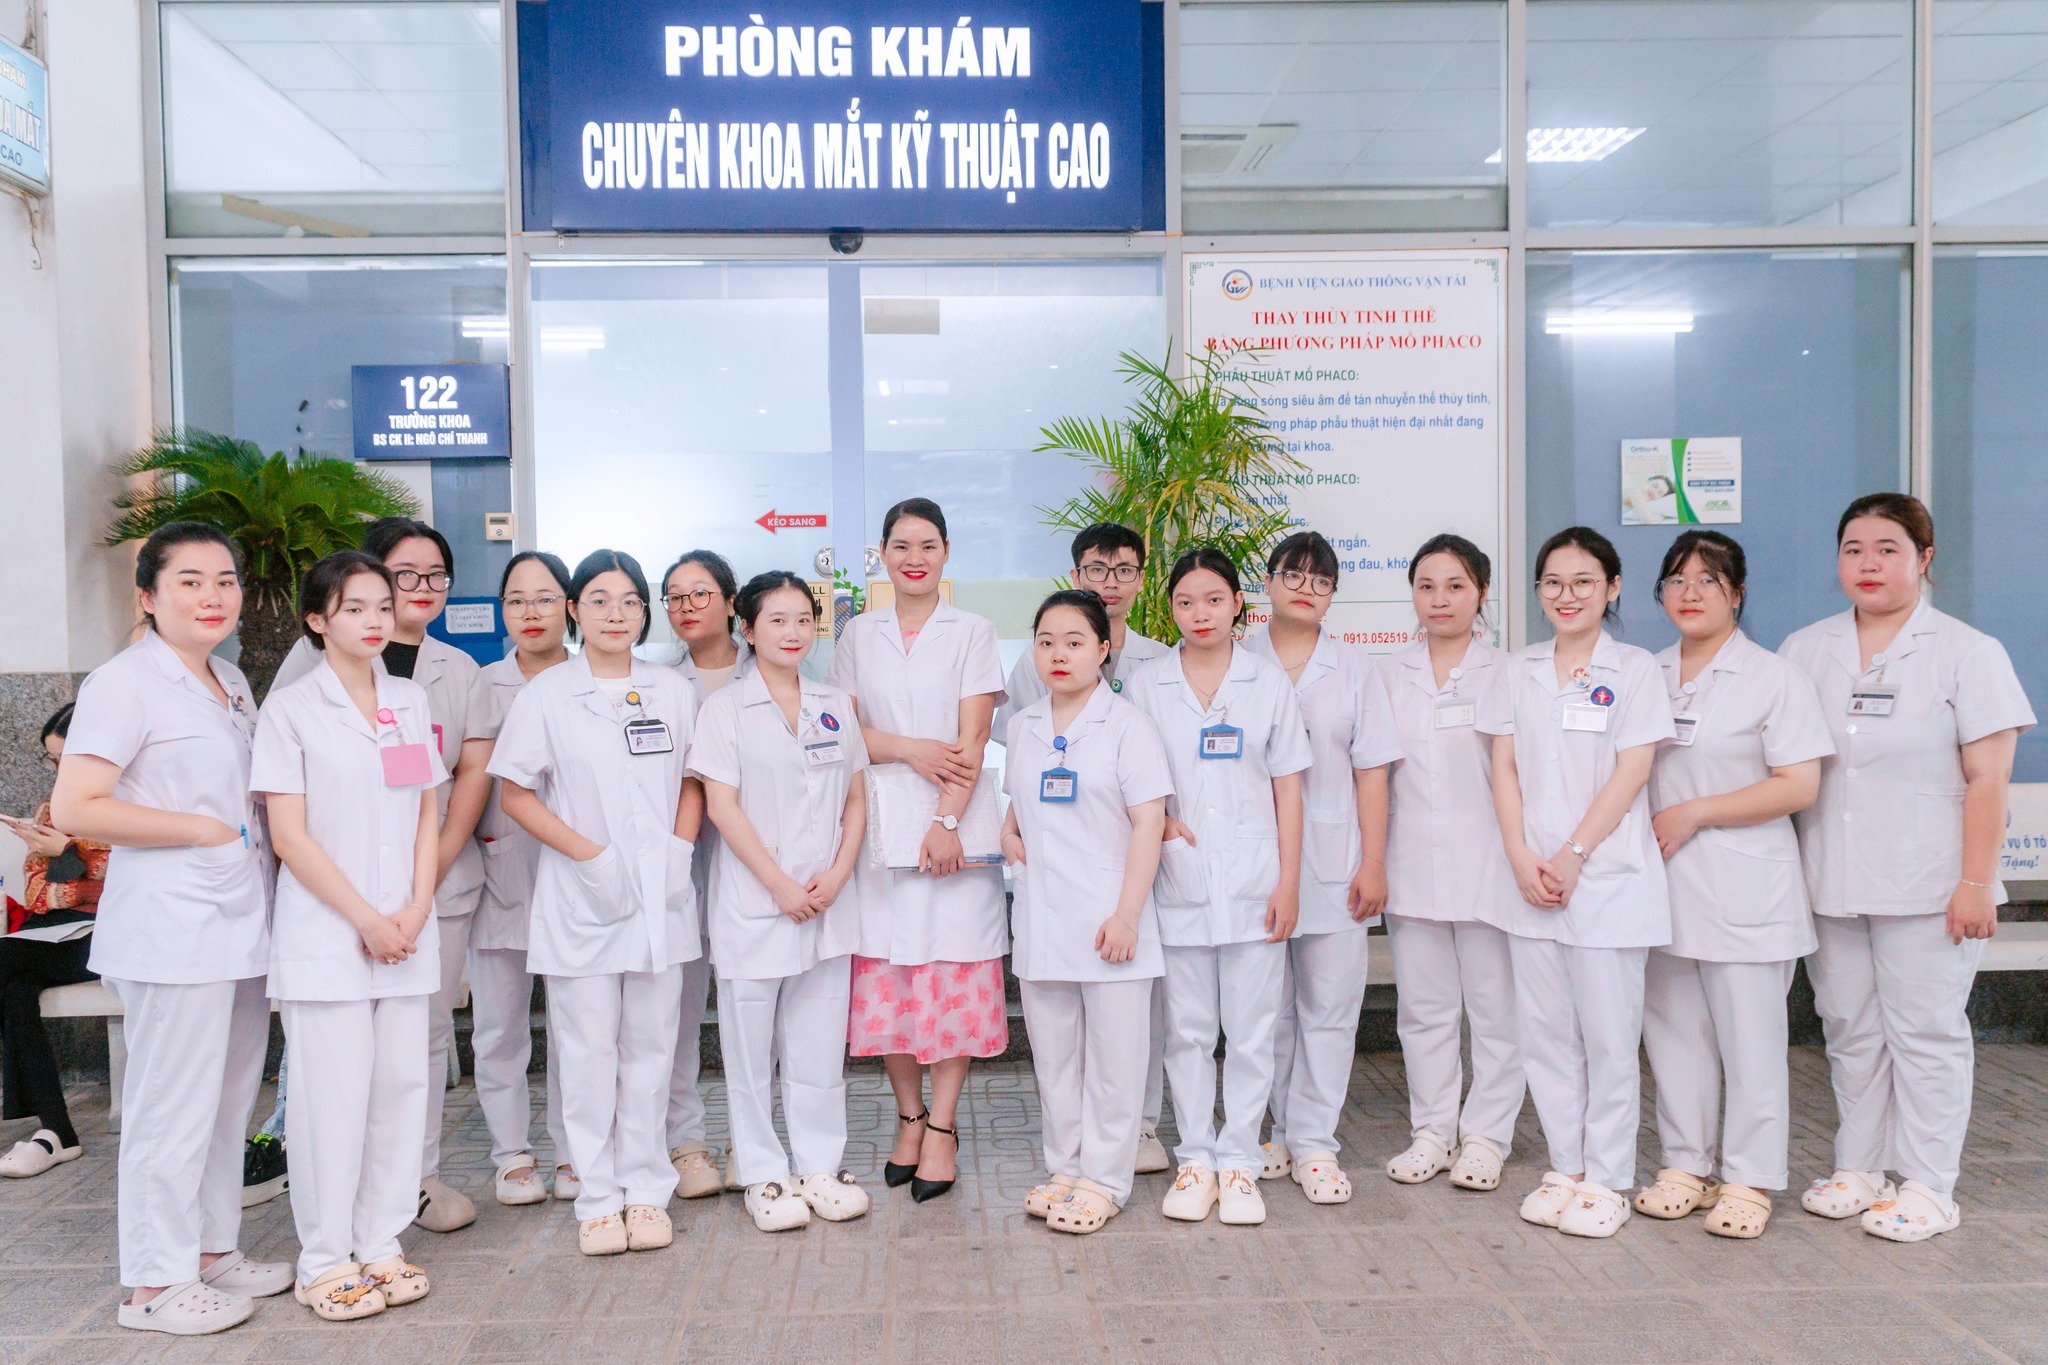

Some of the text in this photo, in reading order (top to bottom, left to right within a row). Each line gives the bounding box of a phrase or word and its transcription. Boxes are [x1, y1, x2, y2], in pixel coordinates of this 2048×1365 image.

[665, 14, 1031, 77] PHÒNG KHÁM
[15, 101, 41, 153] MẮT
[0, 144, 22, 166] CAO
[582, 97, 1110, 204] CHUYÊN KHOA MẮT KỸ THUẬT CAO
[1260, 277, 1293, 291] BỆNH
[1297, 277, 1327, 291] VIỆN
[1331, 277, 1364, 288] GIAO
[1367, 273, 1412, 287] THÔNG
[1252, 306, 1437, 325] THAY THỦY TINH THỂ
[1261, 334, 1334, 350] PHƯƠNG
[1340, 331, 1384, 349] PHÁP
[1389, 331, 1417, 349] MỔ
[1423, 334, 1482, 349] PHACO
[1251, 368, 1291, 383] THUẬT
[1295, 365, 1313, 381] MỔ
[1316, 370, 1359, 381] PHACO:
[400, 376, 458, 410] 122
[1261, 395, 1288, 409] sóng
[1292, 394, 1315, 406] siêu
[1318, 394, 1334, 406] âm
[1338, 391, 1351, 405] để
[1354, 394, 1372, 405] tán
[1375, 391, 1416, 407] nhuyễn
[1419, 390, 1436, 404] thể
[389, 410, 471, 429] TRƯỞNG KHOA
[1290, 418, 1317, 431] pháp
[1320, 415, 1348, 431] phẫu
[1351, 416, 1379, 430] thuật
[1382, 416, 1406, 430] hiện
[1409, 416, 1426, 430] đại
[1429, 413, 1453, 428] nhất
[1456, 416, 1484, 430] đang
[373, 433, 387, 446] BS
[389, 433, 403, 446] CK
[416, 431, 436, 446] NGÔ
[438, 430, 454, 446] CHÍ
[456, 432, 488, 446] THANH
[1287, 441, 1301, 455] tại
[1304, 440, 1334, 452] khoa.
[1630, 445, 1659, 453] Ortho-K
[1317, 473, 1360, 485] PHACO:
[1262, 491, 1291, 506] nhất.
[767, 516, 816, 526] KÉO SANG
[1338, 534, 1371, 551] ngắn.
[1359, 558, 1384, 571] đau,
[1387, 557, 1412, 569] khô
[1248, 612, 1272, 623] tho
[1343, 632, 1409, 644] 0913.052519
